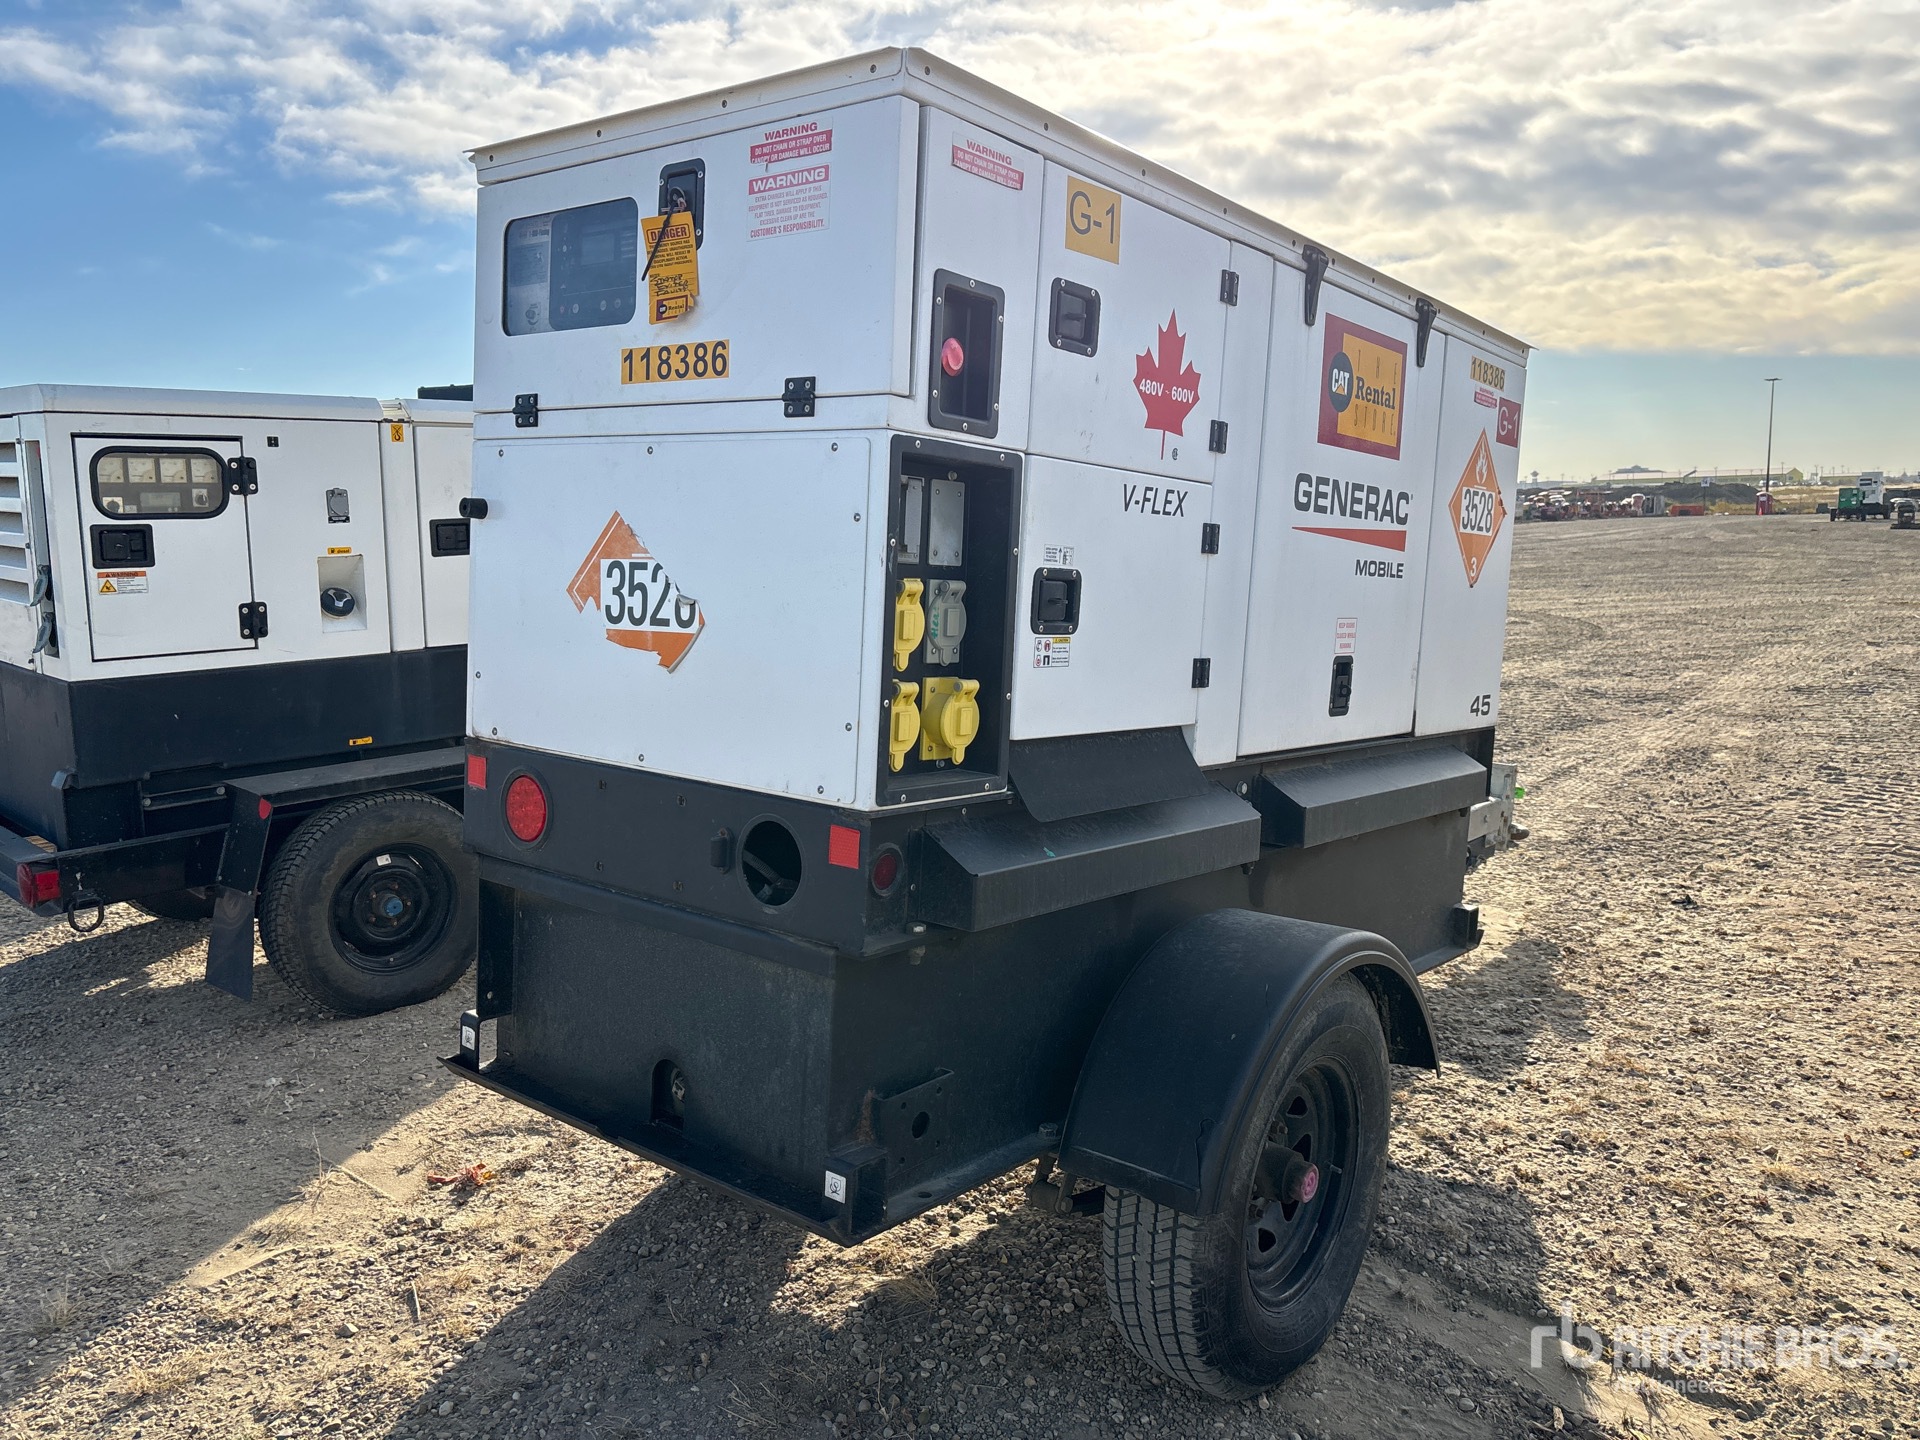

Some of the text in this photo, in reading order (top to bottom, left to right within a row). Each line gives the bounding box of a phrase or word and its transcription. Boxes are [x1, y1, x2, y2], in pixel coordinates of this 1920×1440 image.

[755, 147, 762, 155] DO
[763, 145, 772, 154] NOT
[773, 142, 788, 152] CHAIN
[797, 137, 812, 146] STRAP
[813, 134, 827, 143] OVER
[765, 122, 818, 141] WARNING
[751, 143, 830, 164] CANOPY OR DAMAGE WILL OCCUR
[967, 139, 1012, 165] WARNING
[752, 168, 825, 192] WARNING
[1069, 190, 1115, 244] G-1
[750, 225, 782, 238] CUSTOMER'S
[623, 340, 727, 382] 118386
[1471, 357, 1506, 390] 118386
[1139, 378, 1164, 397] 480V
[1171, 386, 1195, 404] 600V
[1331, 368, 1396, 410] CAT Rental
[1499, 406, 1519, 439] G-1
[1123, 483, 1188, 517] V-FLEX
[1294, 472, 1410, 526] GENERAC
[1461, 488, 1494, 534] 3528
[1355, 559, 1405, 579] MOBILE
[1470, 556, 1477, 577] 3
[1470, 694, 1491, 717] 45
